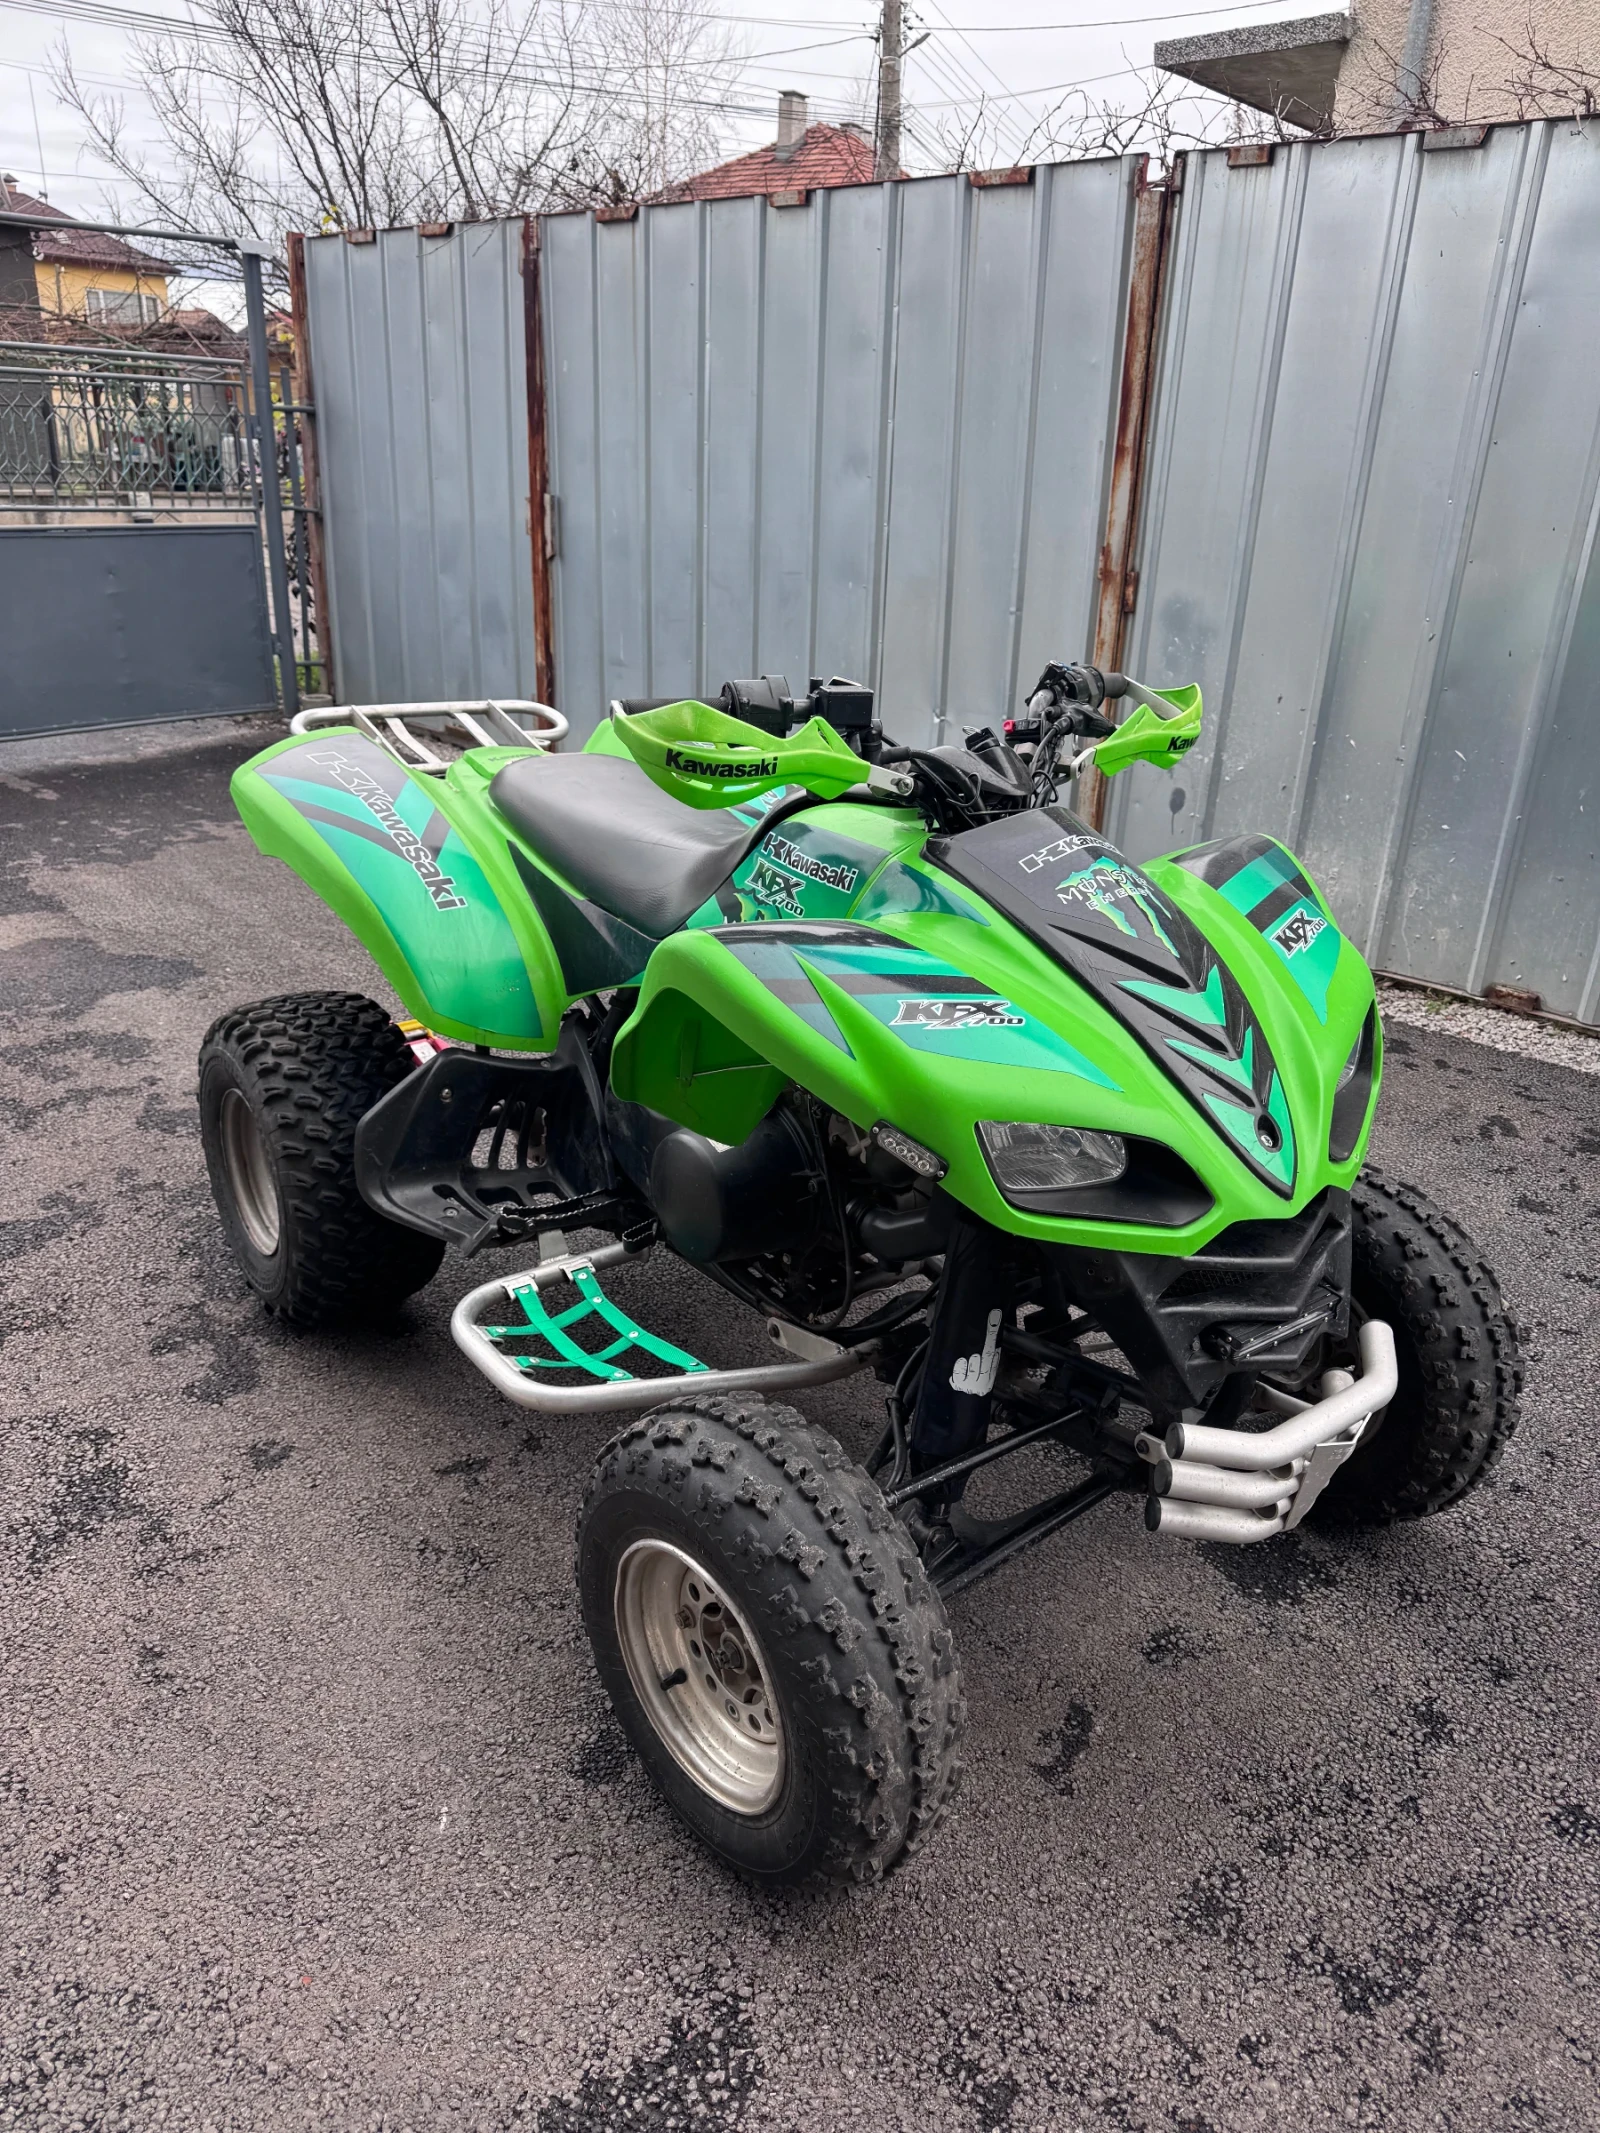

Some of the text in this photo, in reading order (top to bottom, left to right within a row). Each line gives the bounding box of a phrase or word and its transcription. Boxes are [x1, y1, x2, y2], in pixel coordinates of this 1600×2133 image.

[665, 748, 778, 778] Kawasaki
[358, 785, 468, 912] Kawasaki
[783, 845, 859, 894] Kawasaki
[745, 858, 805, 909] KFX
[776, 896, 805, 918] 700
[1269, 909, 1326, 959] KFX 700
[888, 999, 1026, 1030] KFX 700
